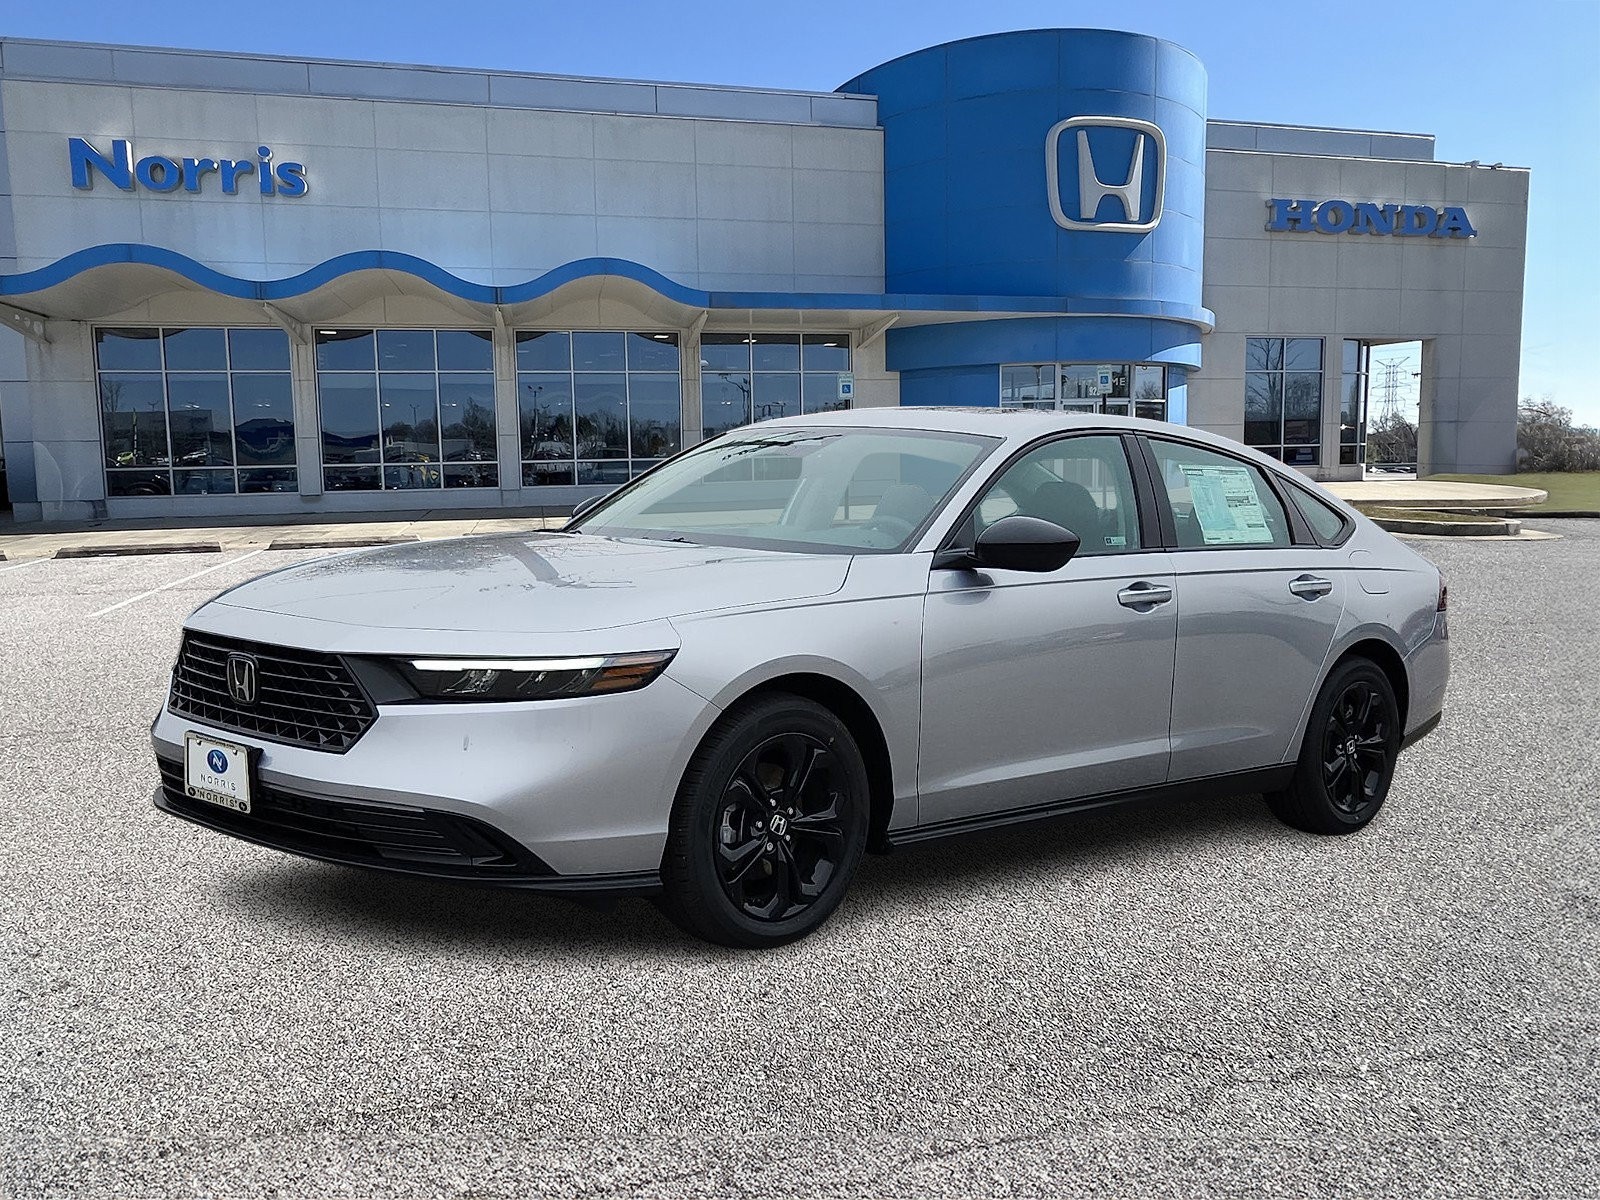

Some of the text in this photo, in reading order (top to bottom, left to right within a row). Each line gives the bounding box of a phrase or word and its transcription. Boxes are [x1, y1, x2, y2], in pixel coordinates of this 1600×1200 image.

[67, 137, 308, 197] Norris
[1265, 198, 1478, 239] HONDA
[200, 773, 236, 791] NORRIS
[199, 790, 235, 808] NORRIS
